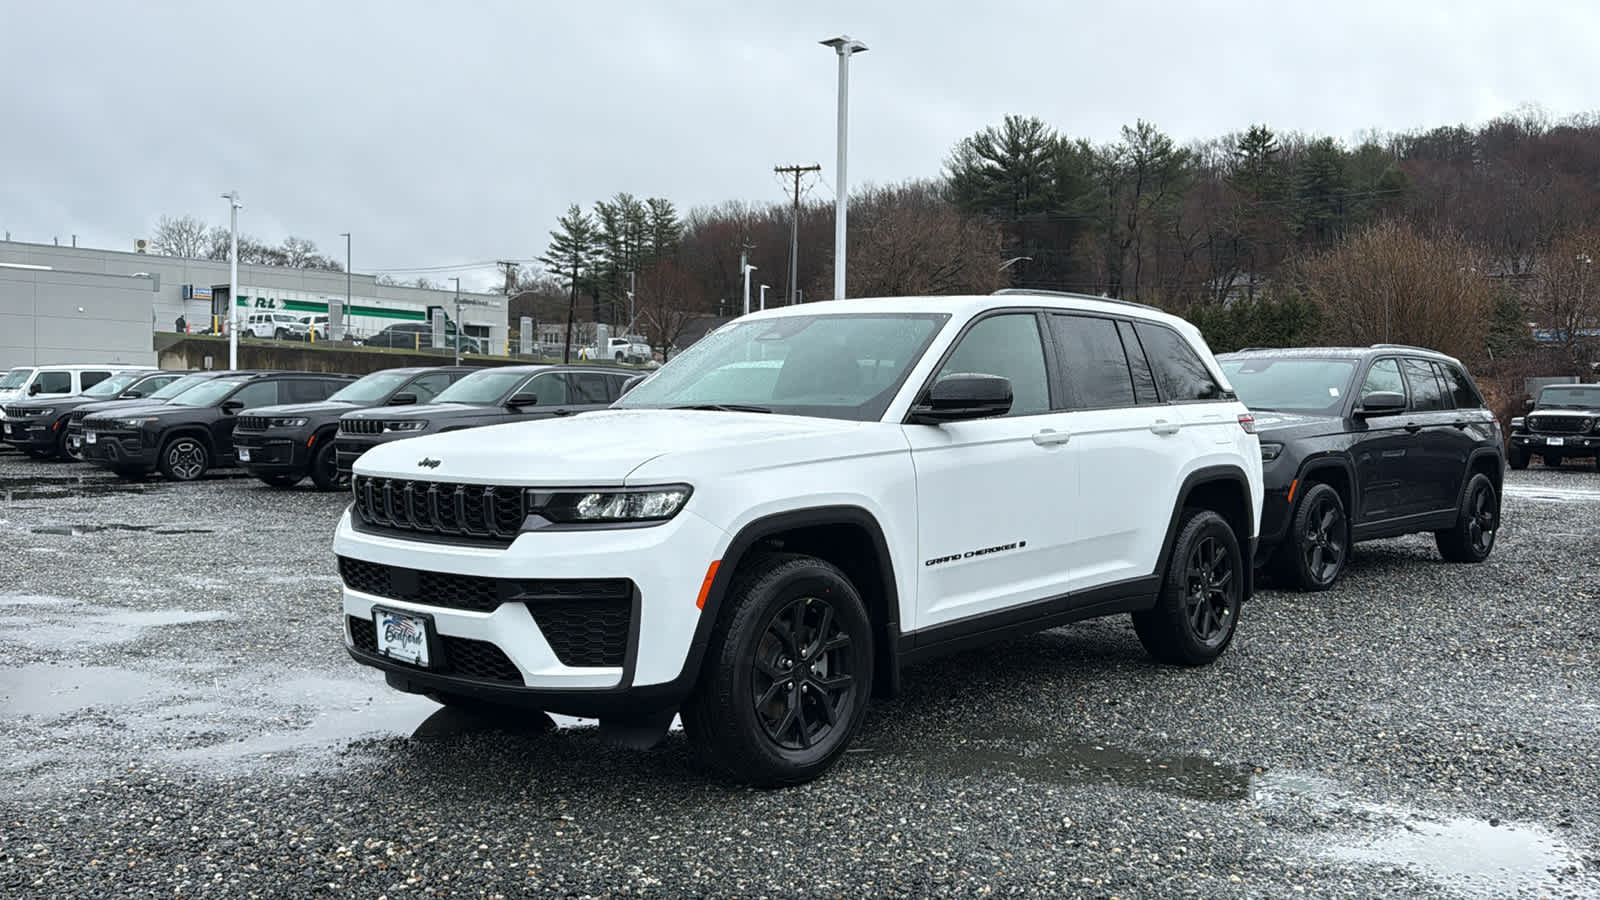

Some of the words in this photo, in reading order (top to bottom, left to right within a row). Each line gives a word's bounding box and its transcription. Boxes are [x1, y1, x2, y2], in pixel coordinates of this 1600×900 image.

[418, 457, 441, 469] Jeep
[925, 554, 961, 566] GRAND
[964, 543, 1017, 558] CHEROKEE
